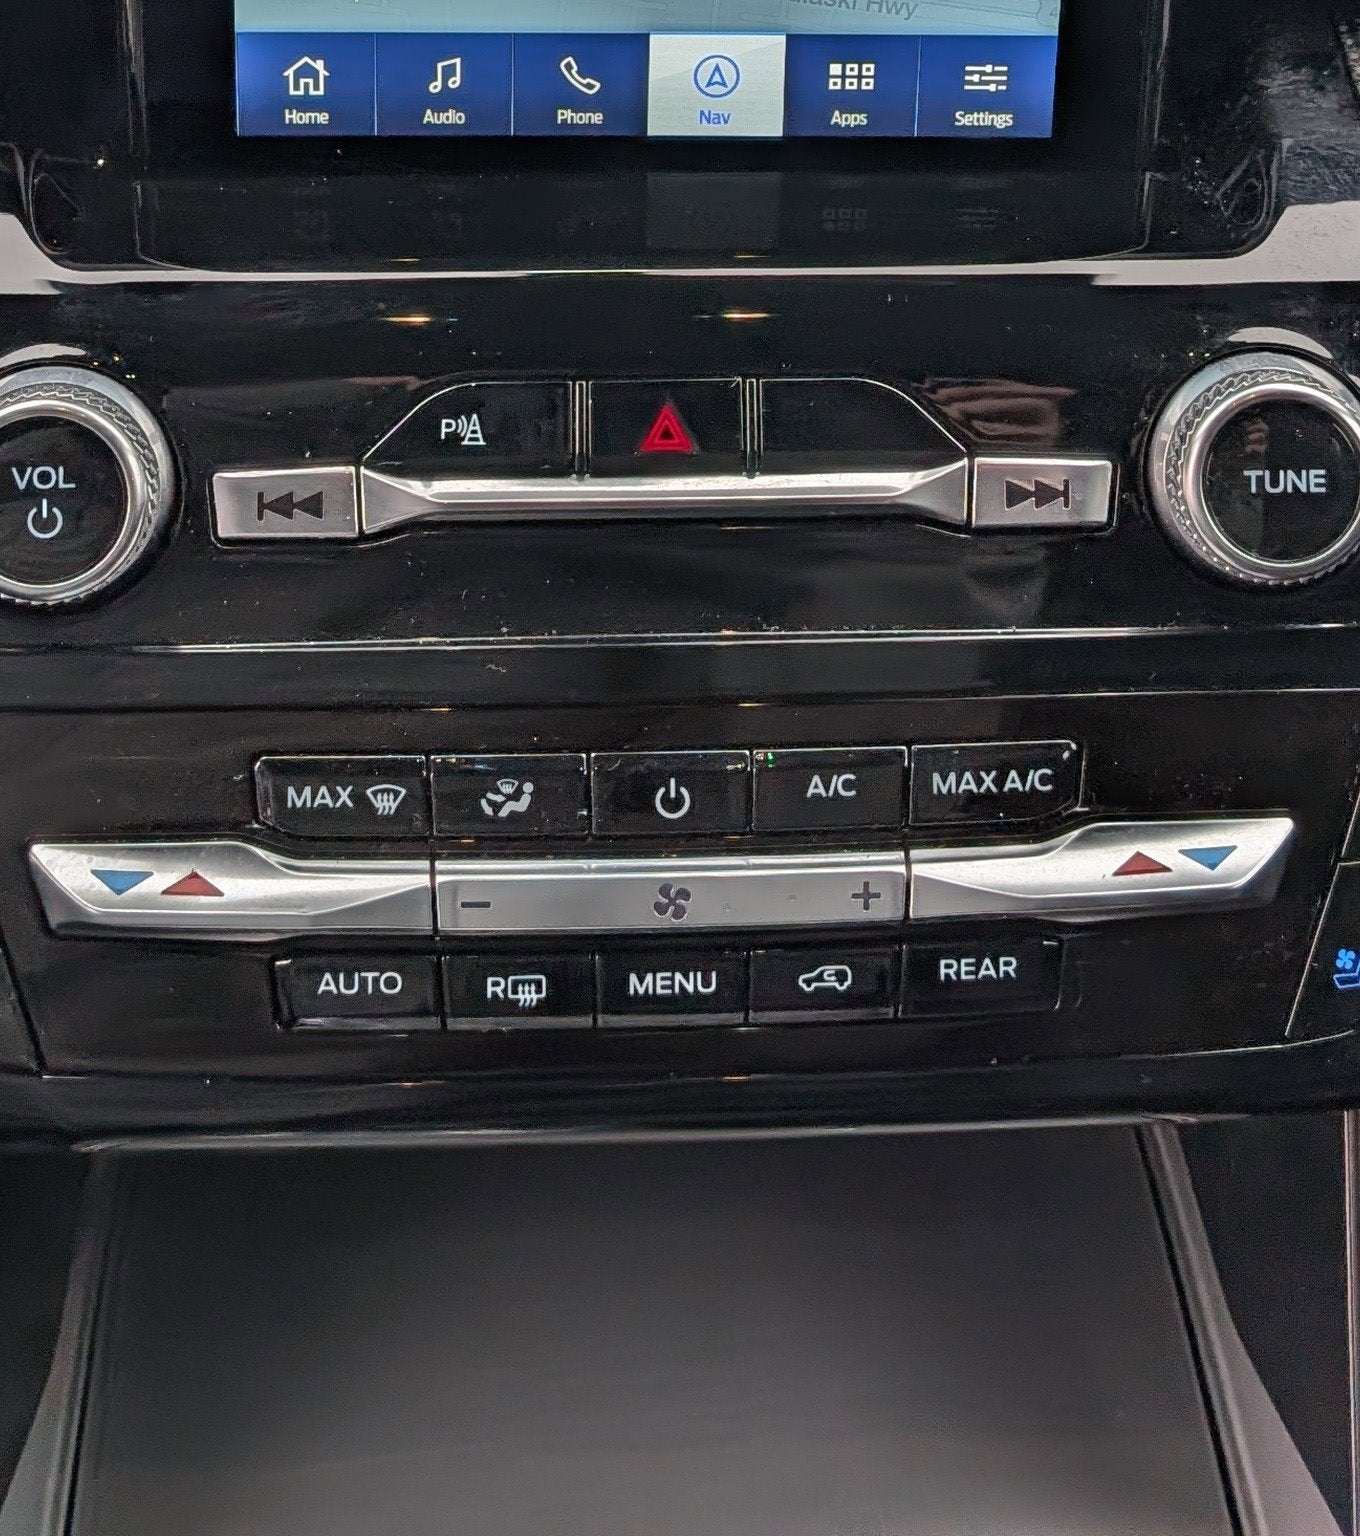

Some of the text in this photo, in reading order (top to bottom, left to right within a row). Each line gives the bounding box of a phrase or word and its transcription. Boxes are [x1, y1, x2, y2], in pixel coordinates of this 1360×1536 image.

[284, 109, 330, 125] Home
[423, 109, 466, 125] Audio
[557, 109, 603, 125] Phone
[699, 110, 731, 126] Nav
[830, 110, 868, 131] Apps
[955, 110, 1014, 131] Settings
[11, 466, 76, 489] VOL
[1243, 469, 1327, 494] TUNE
[806, 774, 857, 798] A/C
[932, 768, 1054, 795] MAX A/C
[287, 785, 355, 809] MAX
[939, 957, 1018, 982] REAR
[318, 972, 403, 996] AUTO
[629, 971, 717, 995] MENU
